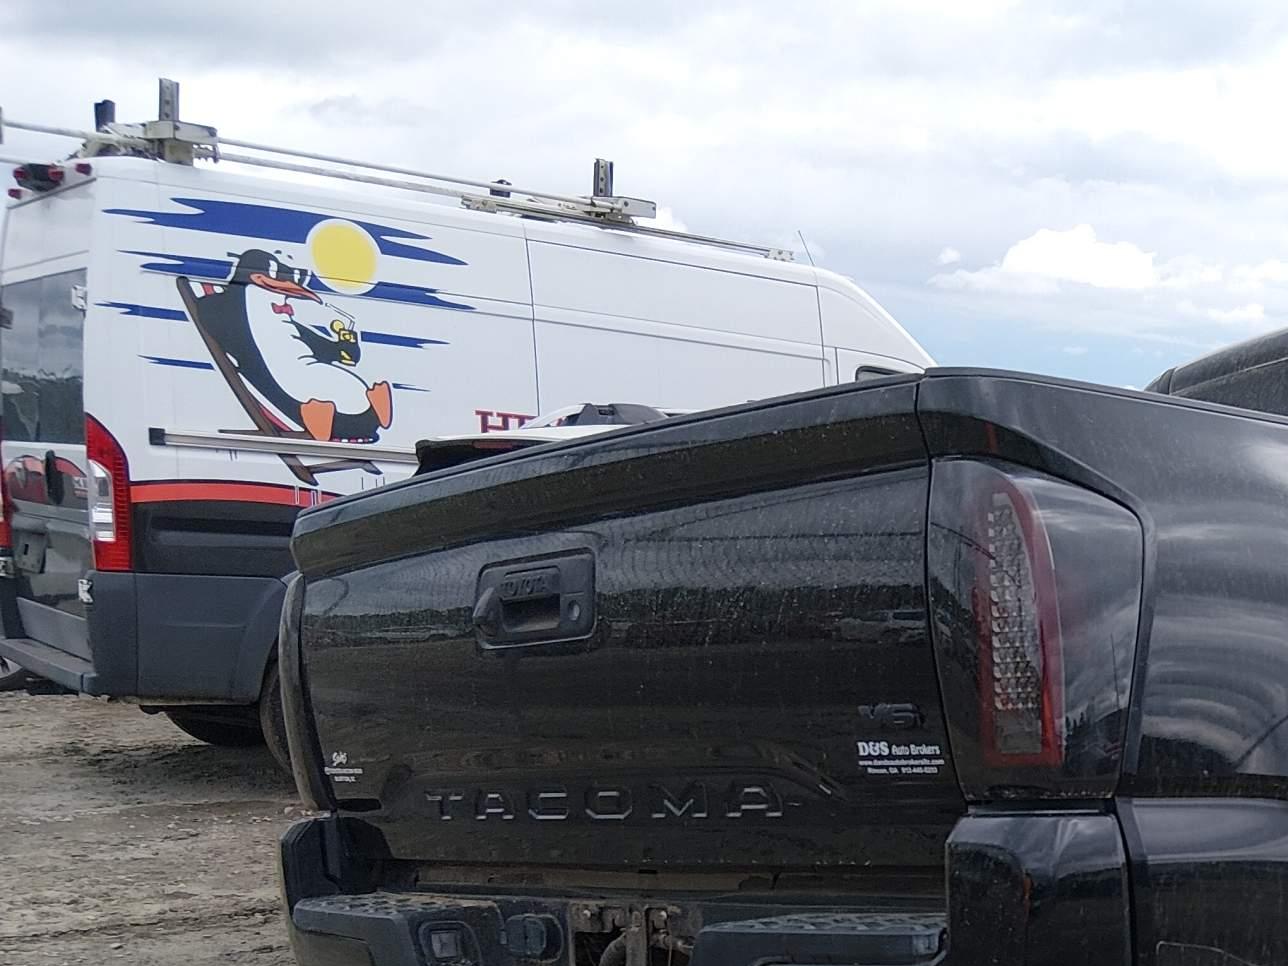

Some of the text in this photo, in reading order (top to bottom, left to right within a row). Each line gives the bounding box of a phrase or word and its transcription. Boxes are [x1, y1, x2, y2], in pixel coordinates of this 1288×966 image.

[857, 741, 941, 757] D&S Auto Brokers
[424, 782, 783, 821] TACOMA
